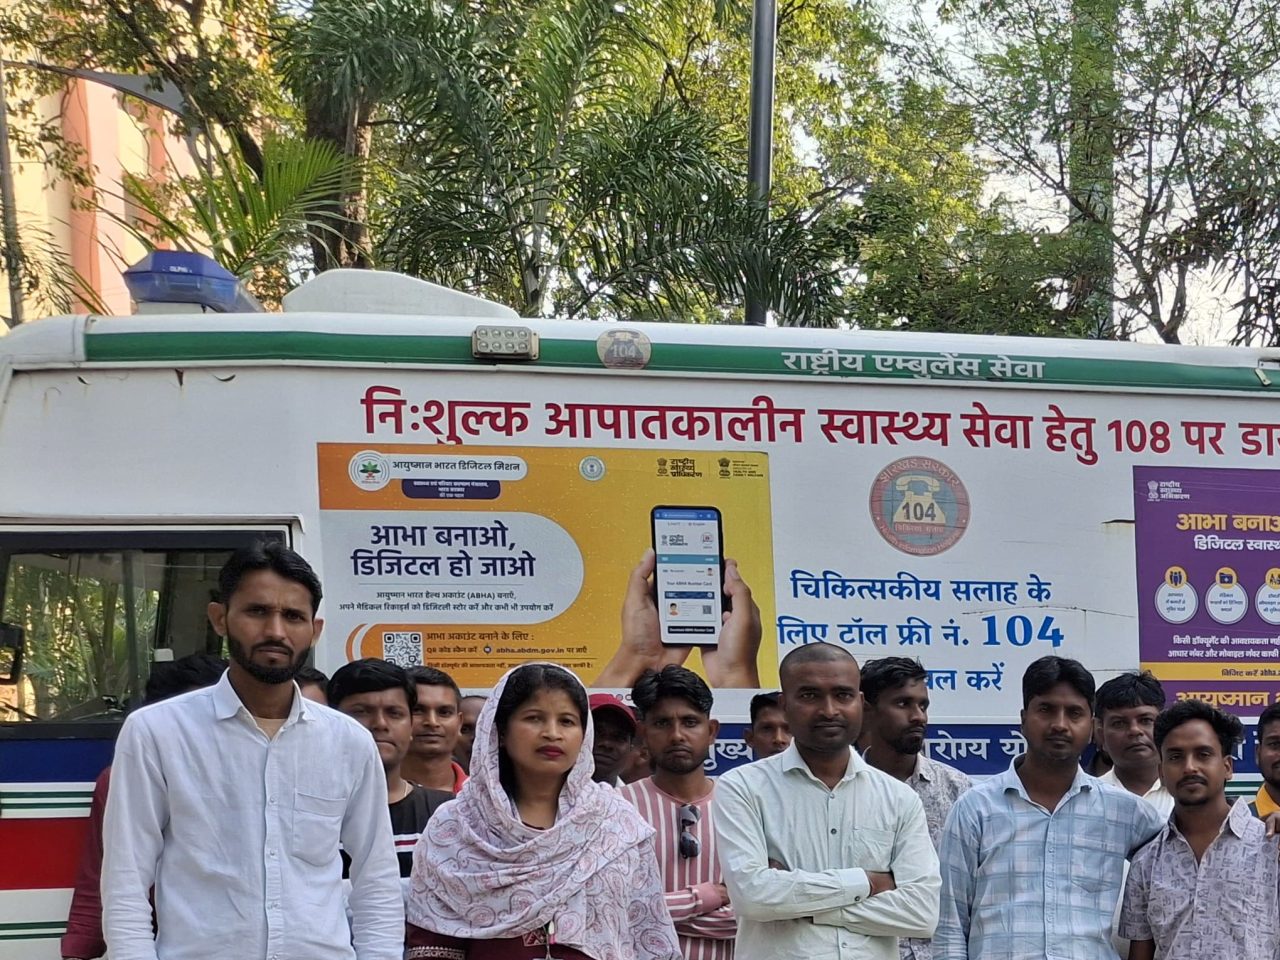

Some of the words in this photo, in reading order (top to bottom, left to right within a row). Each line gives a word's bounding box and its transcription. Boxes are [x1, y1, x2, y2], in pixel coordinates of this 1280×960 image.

[609, 344, 636, 358] 104
[781, 349, 865, 375] राष्ट्रीय
[987, 355, 1046, 378] सेवा
[545, 395, 805, 443] आपातकालीन
[818, 408, 949, 447] स्वास्थ्य
[960, 402, 1033, 449] सेवा
[1042, 404, 1099, 465] हेतु
[1107, 419, 1171, 454] 108
[1181, 421, 1226, 455] पर
[392, 461, 432, 471] आयुष्मान
[434, 461, 456, 470] भारत
[458, 460, 491, 471] डिजिटल
[494, 460, 520, 471] मिशन
[902, 502, 936, 521] 104
[1176, 513, 1227, 531] आभा
[371, 525, 427, 546] आभा
[433, 520, 516, 551] बनाओ,
[1194, 535, 1244, 550] डिजिटल
[350, 549, 441, 576] डिजिटल
[447, 550, 472, 577] हो
[478, 551, 536, 577] जाओ
[467, 592, 495, 600] (ABHA)
[790, 569, 941, 601] चिकित्सकीय
[950, 581, 1018, 605] सलाह
[1026, 574, 1052, 602] के
[339, 602, 354, 610] अपने
[356, 602, 381, 610] मेडिकल
[411, 602, 421, 610] को
[453, 602, 466, 611] स्टोर
[468, 602, 479, 611] करें
[481, 602, 492, 611] और
[495, 603, 508, 611] कभी
[511, 603, 518, 611] भी
[520, 603, 541, 611] उपयोग
[543, 603, 554, 611] करें
[427, 632, 445, 640] आभा
[448, 631, 476, 640] अकाउंट
[478, 631, 498, 640] बनाने
[501, 631, 510, 640] के
[512, 630, 528, 640] लिए
[776, 615, 828, 644] लिए
[837, 617, 888, 645] टॉल
[896, 616, 932, 646] फ्री
[941, 619, 969, 646] नं.
[982, 614, 1065, 648] 104
[1173, 635, 1190, 645] किसी
[1220, 635, 1229, 645] की
[1205, 648, 1218, 657] और
[964, 661, 1005, 691] करें
